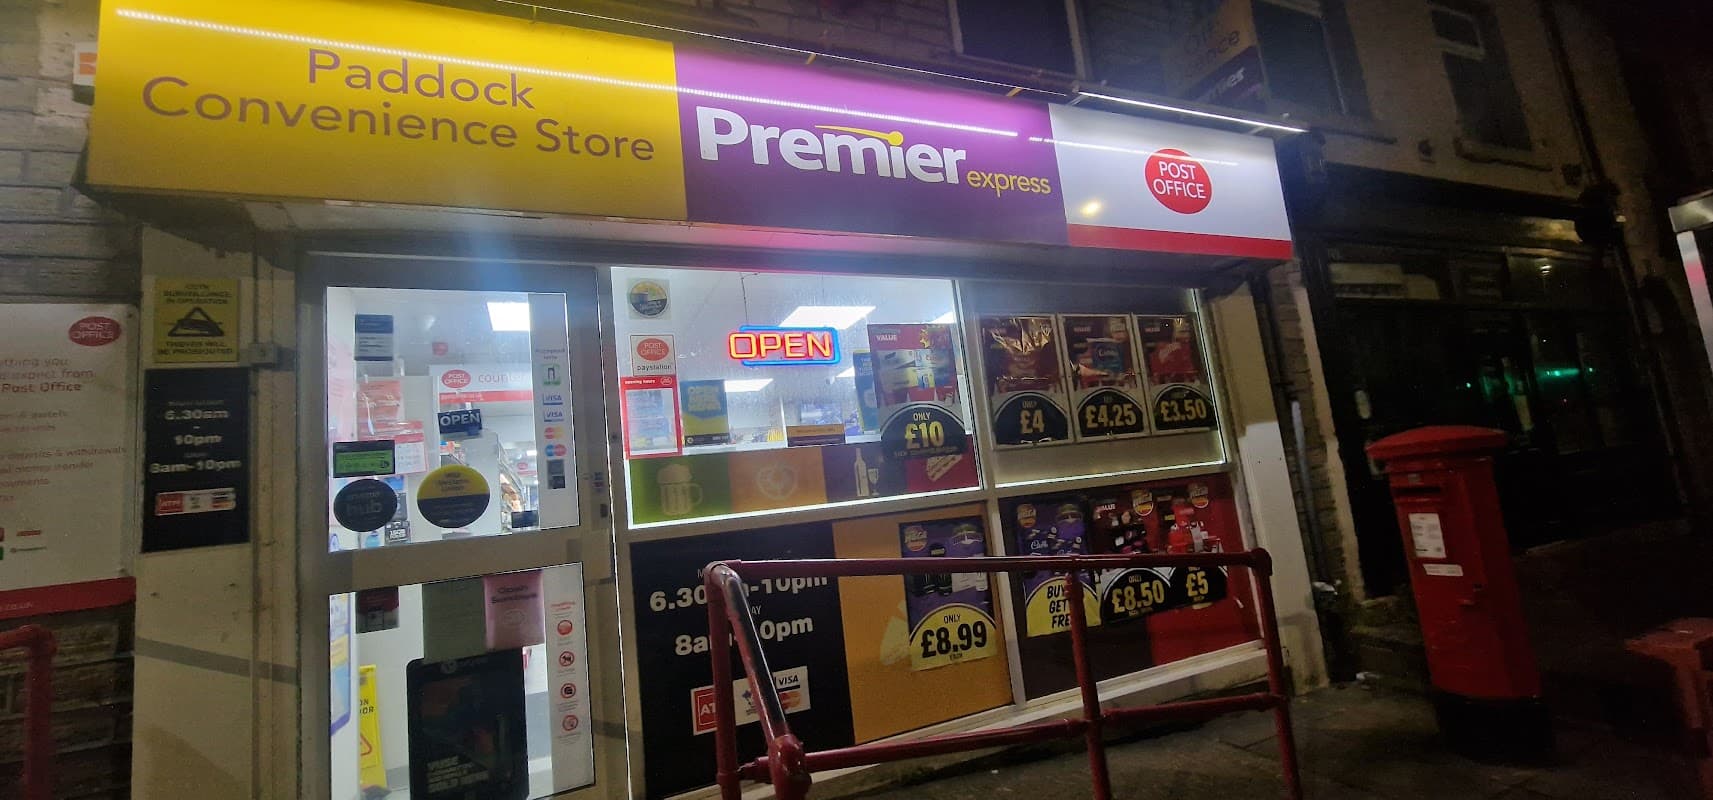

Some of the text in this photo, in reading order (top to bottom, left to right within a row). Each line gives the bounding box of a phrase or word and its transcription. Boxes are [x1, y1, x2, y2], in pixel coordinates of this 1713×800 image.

[308, 47, 535, 110] Paddock
[142, 75, 656, 162] Convenience Store
[696, 105, 1052, 198] Premier express
[1158, 160, 1197, 181] POST
[1153, 178, 1207, 200] OFFICE
[79, 322, 113, 331] POST
[72, 330, 115, 340] OFFICE
[876, 334, 898, 342] VALUE
[640, 348, 666, 356] OFFICE
[729, 331, 833, 360] OPEN
[1, 381, 82, 393] Post Office
[164, 409, 230, 421] 6.30am
[546, 410, 563, 418] VISA
[913, 412, 931, 422] ONLY
[1085, 404, 1137, 429] £4.25
[1160, 399, 1207, 423] £3.50
[440, 412, 481, 426] OPEN
[1019, 408, 1046, 434] £4
[174, 434, 222, 446] 10pm
[904, 421, 945, 449] £10
[1185, 570, 1209, 598] £5
[1111, 579, 1165, 615] £8.50
[1049, 599, 1069, 614] GET
[943, 614, 961, 624] ONLY
[1052, 614, 1071, 629] FRE
[921, 621, 987, 659] £8.99
[778, 674, 800, 686] VISA
[700, 702, 717, 716] AT
